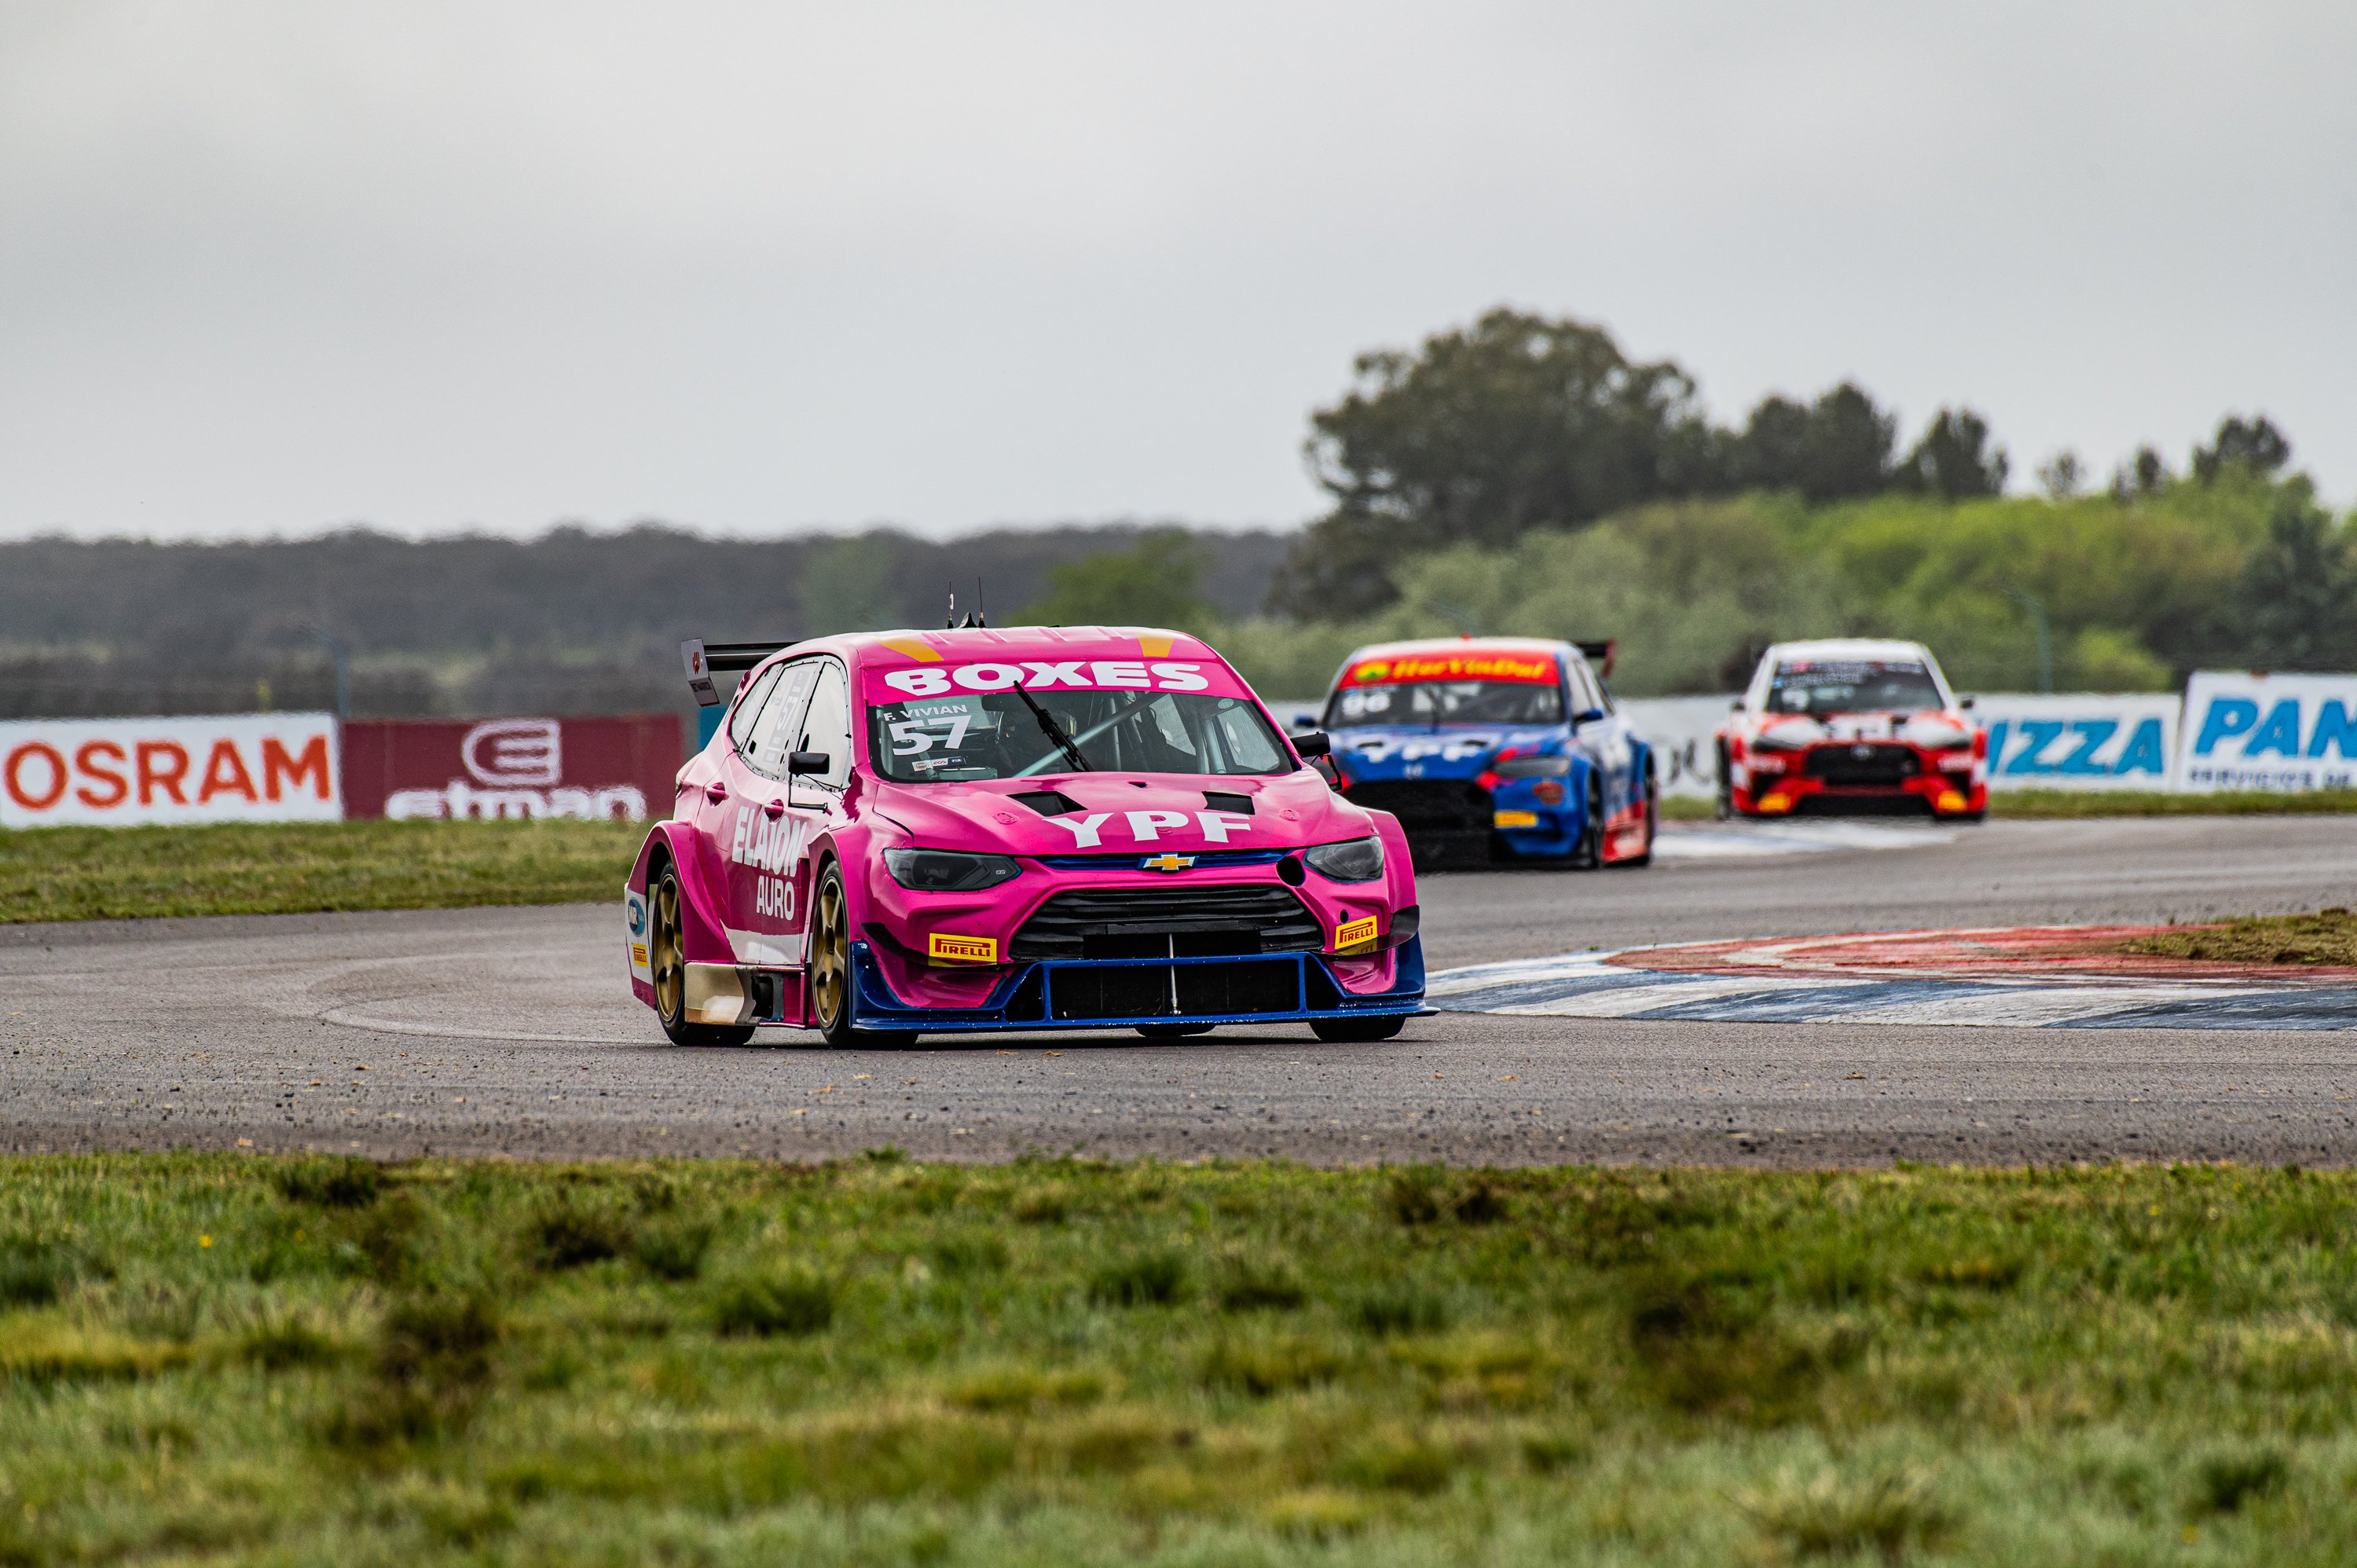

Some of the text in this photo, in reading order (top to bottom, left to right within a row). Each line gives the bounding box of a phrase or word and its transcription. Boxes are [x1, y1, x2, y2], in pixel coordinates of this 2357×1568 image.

[885, 661, 1208, 696] BOXES
[883, 704, 968, 722] F. VIVIAN
[888, 715, 973, 757] 57
[1988, 718, 2163, 775] IZZA
[4, 735, 331, 811] OSRAM
[731, 805, 808, 877] ELAION
[1041, 810, 1252, 849] YPF
[756, 875, 795, 921] AURO
[934, 937, 992, 958] PIRELLI
[1338, 921, 1373, 943] PIRELLI
